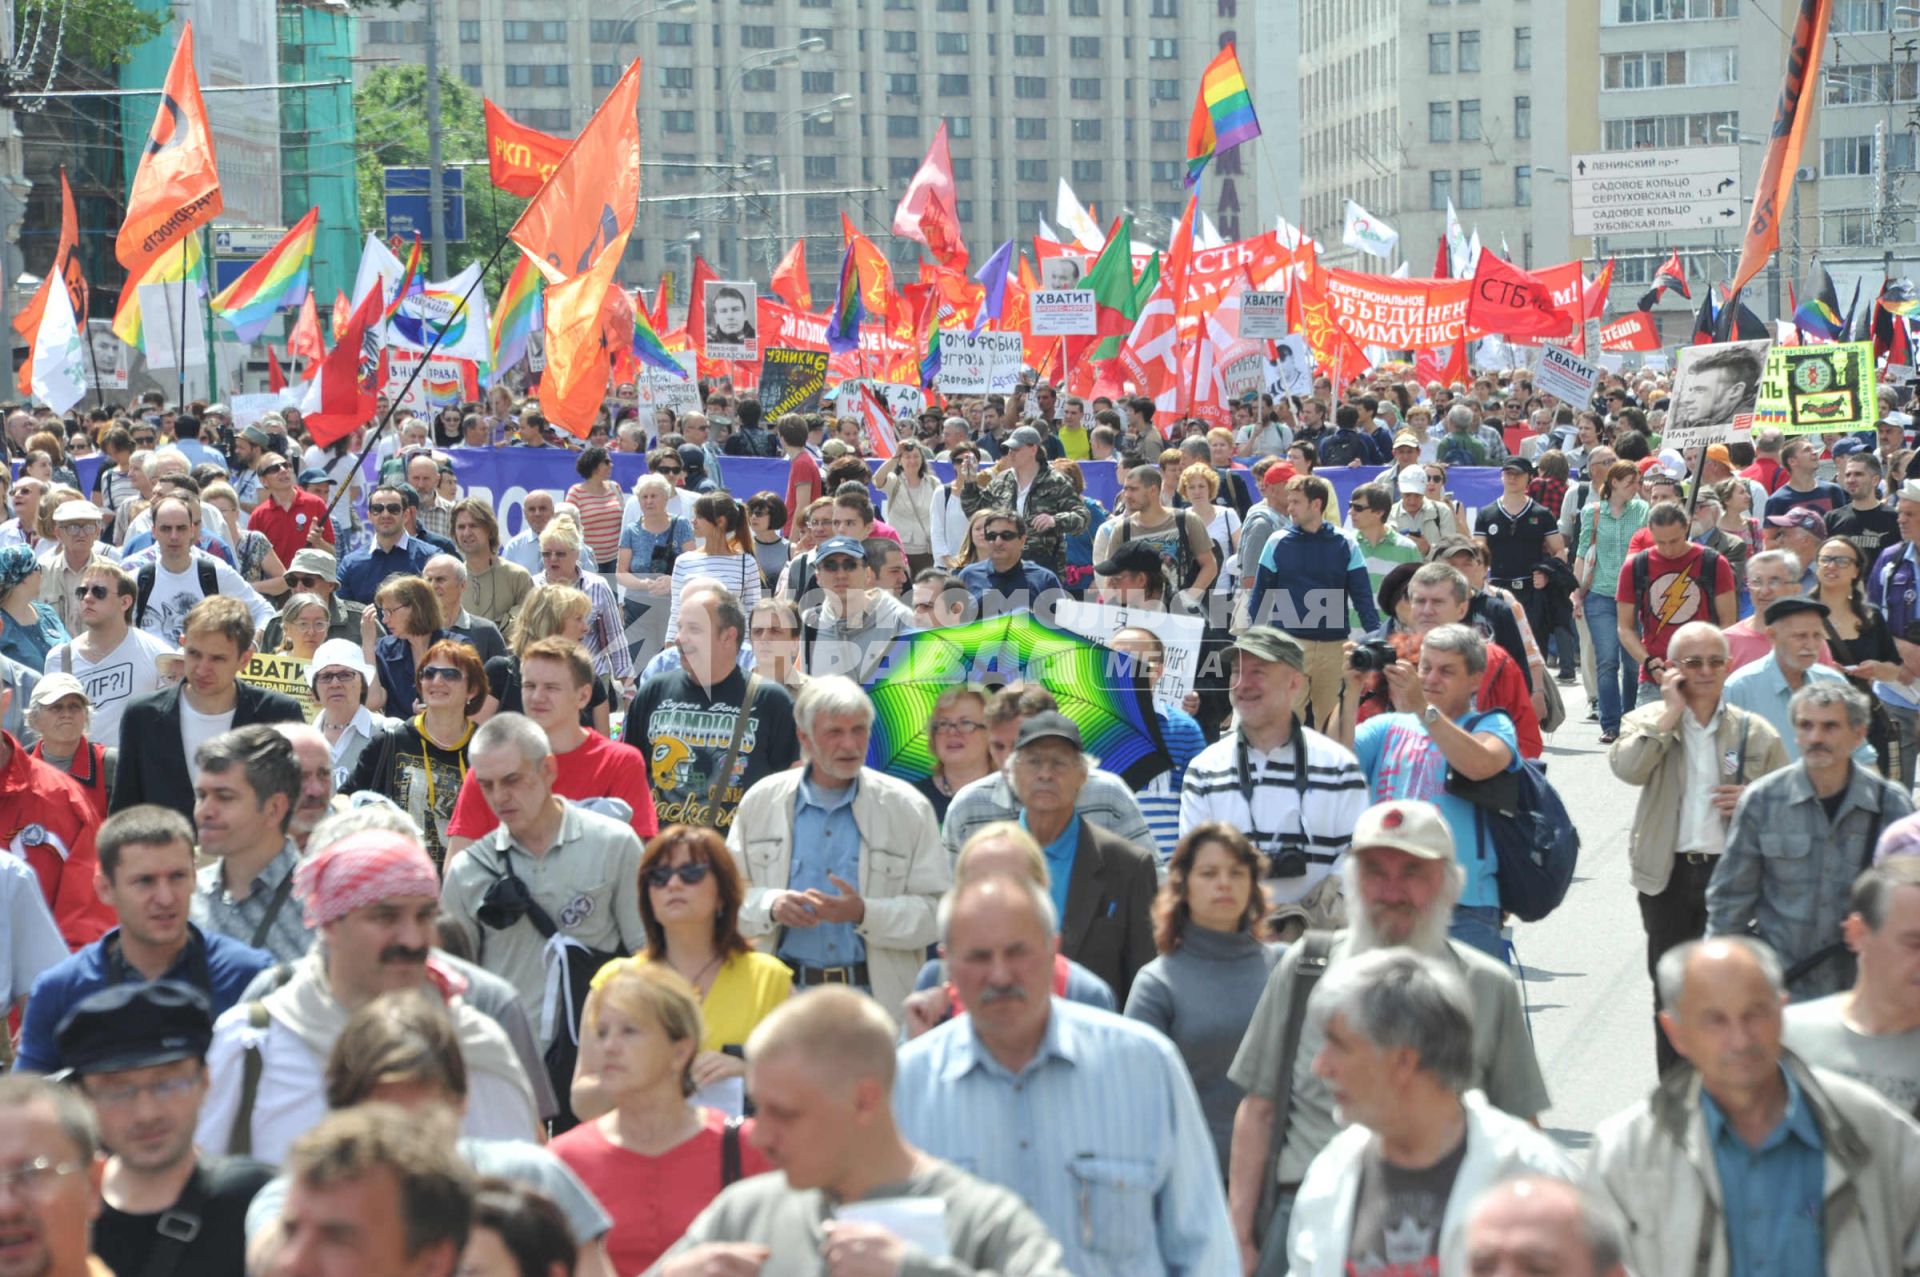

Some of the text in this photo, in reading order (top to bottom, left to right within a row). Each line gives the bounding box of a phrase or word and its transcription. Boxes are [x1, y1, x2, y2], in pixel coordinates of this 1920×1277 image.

[1591, 159, 1656, 171] ЛЕНИНСКИЙ
[1591, 177, 1690, 192] САДОВОЕ КОЛЬЦО
[1591, 193, 1676, 204] СЕРПУХОВСКАЯ
[1592, 205, 1691, 220] САДОВОЕ КОЛЬЦО
[1593, 221, 1656, 232] ЗУБОВСКАЯ
[1036, 293, 1091, 304] ХВАТИТ
[1244, 295, 1285, 306] ХВАТИТ
[767, 349, 815, 365] УЗНИКИ
[1546, 347, 1595, 379] ХВАТИТ
[1667, 431, 1695, 440] ИЛЬЯ
[1684, 435, 1727, 447] ГУЩИН
[657, 699, 702, 713] Super
